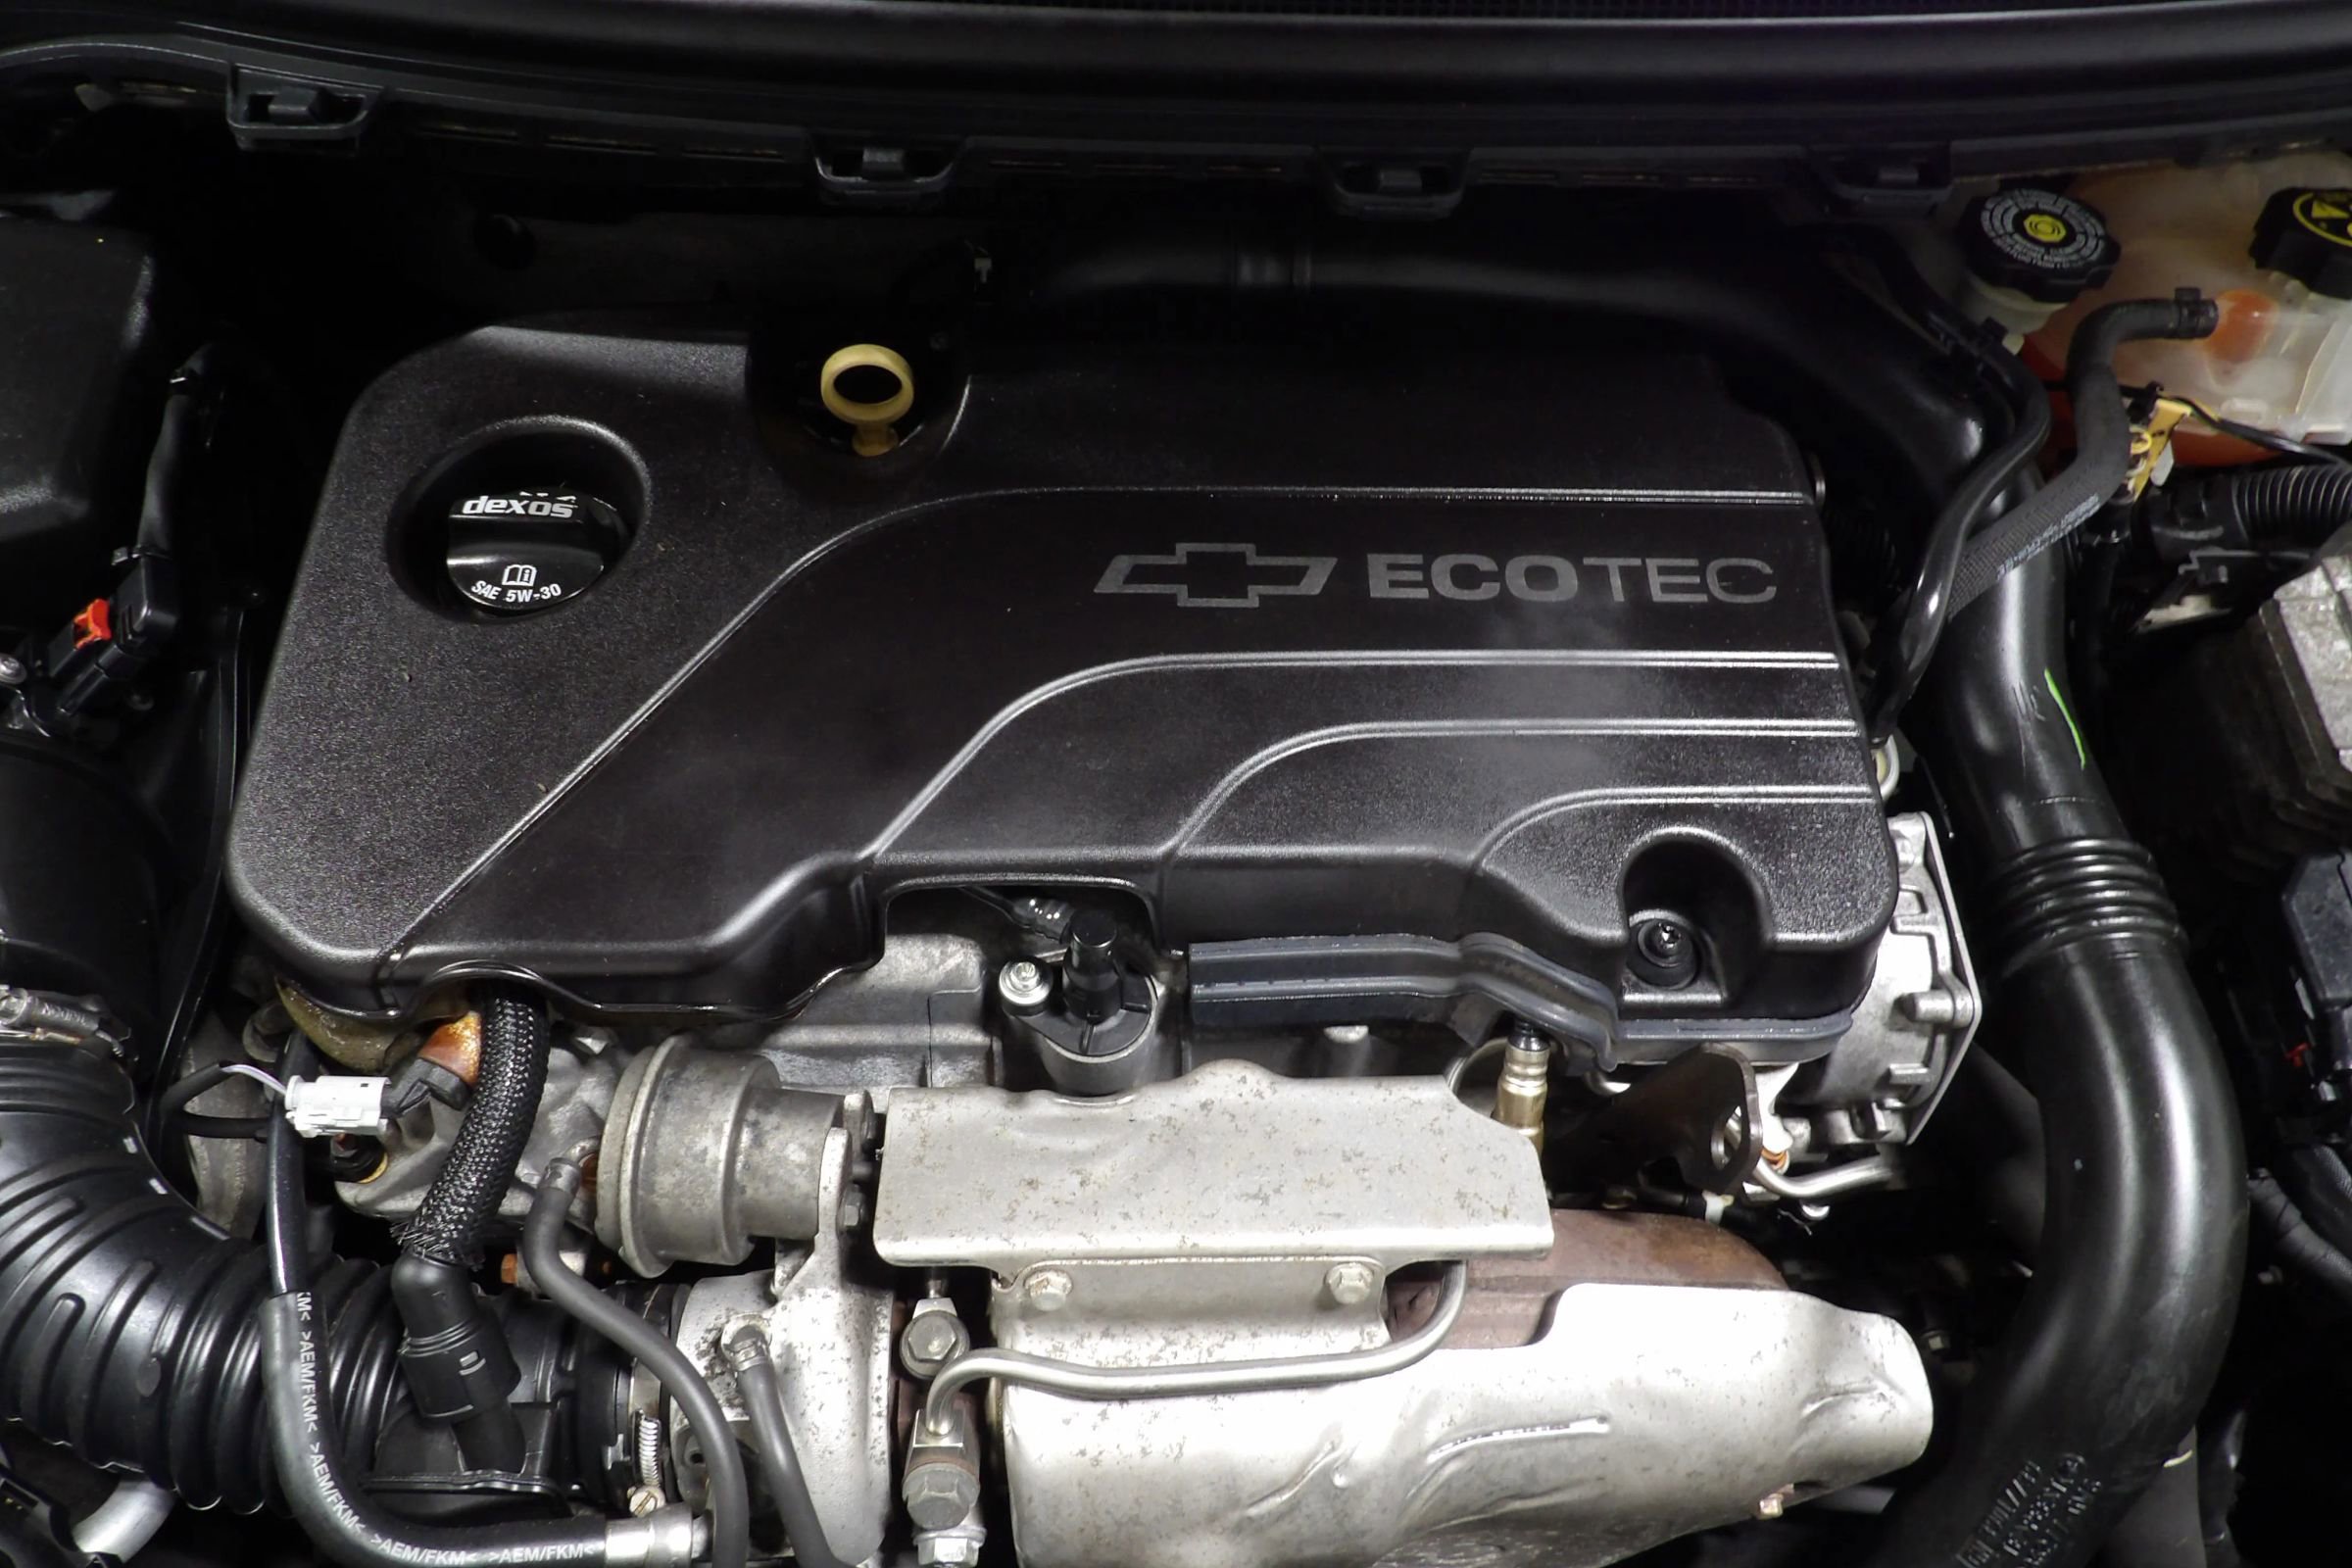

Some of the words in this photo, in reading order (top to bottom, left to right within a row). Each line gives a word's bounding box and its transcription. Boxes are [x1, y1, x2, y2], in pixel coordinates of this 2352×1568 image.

[463, 496, 573, 517] dexos
[1367, 554, 1777, 604] ECOTEC
[471, 581, 502, 600] SAE
[505, 583, 562, 603] 5W-30
